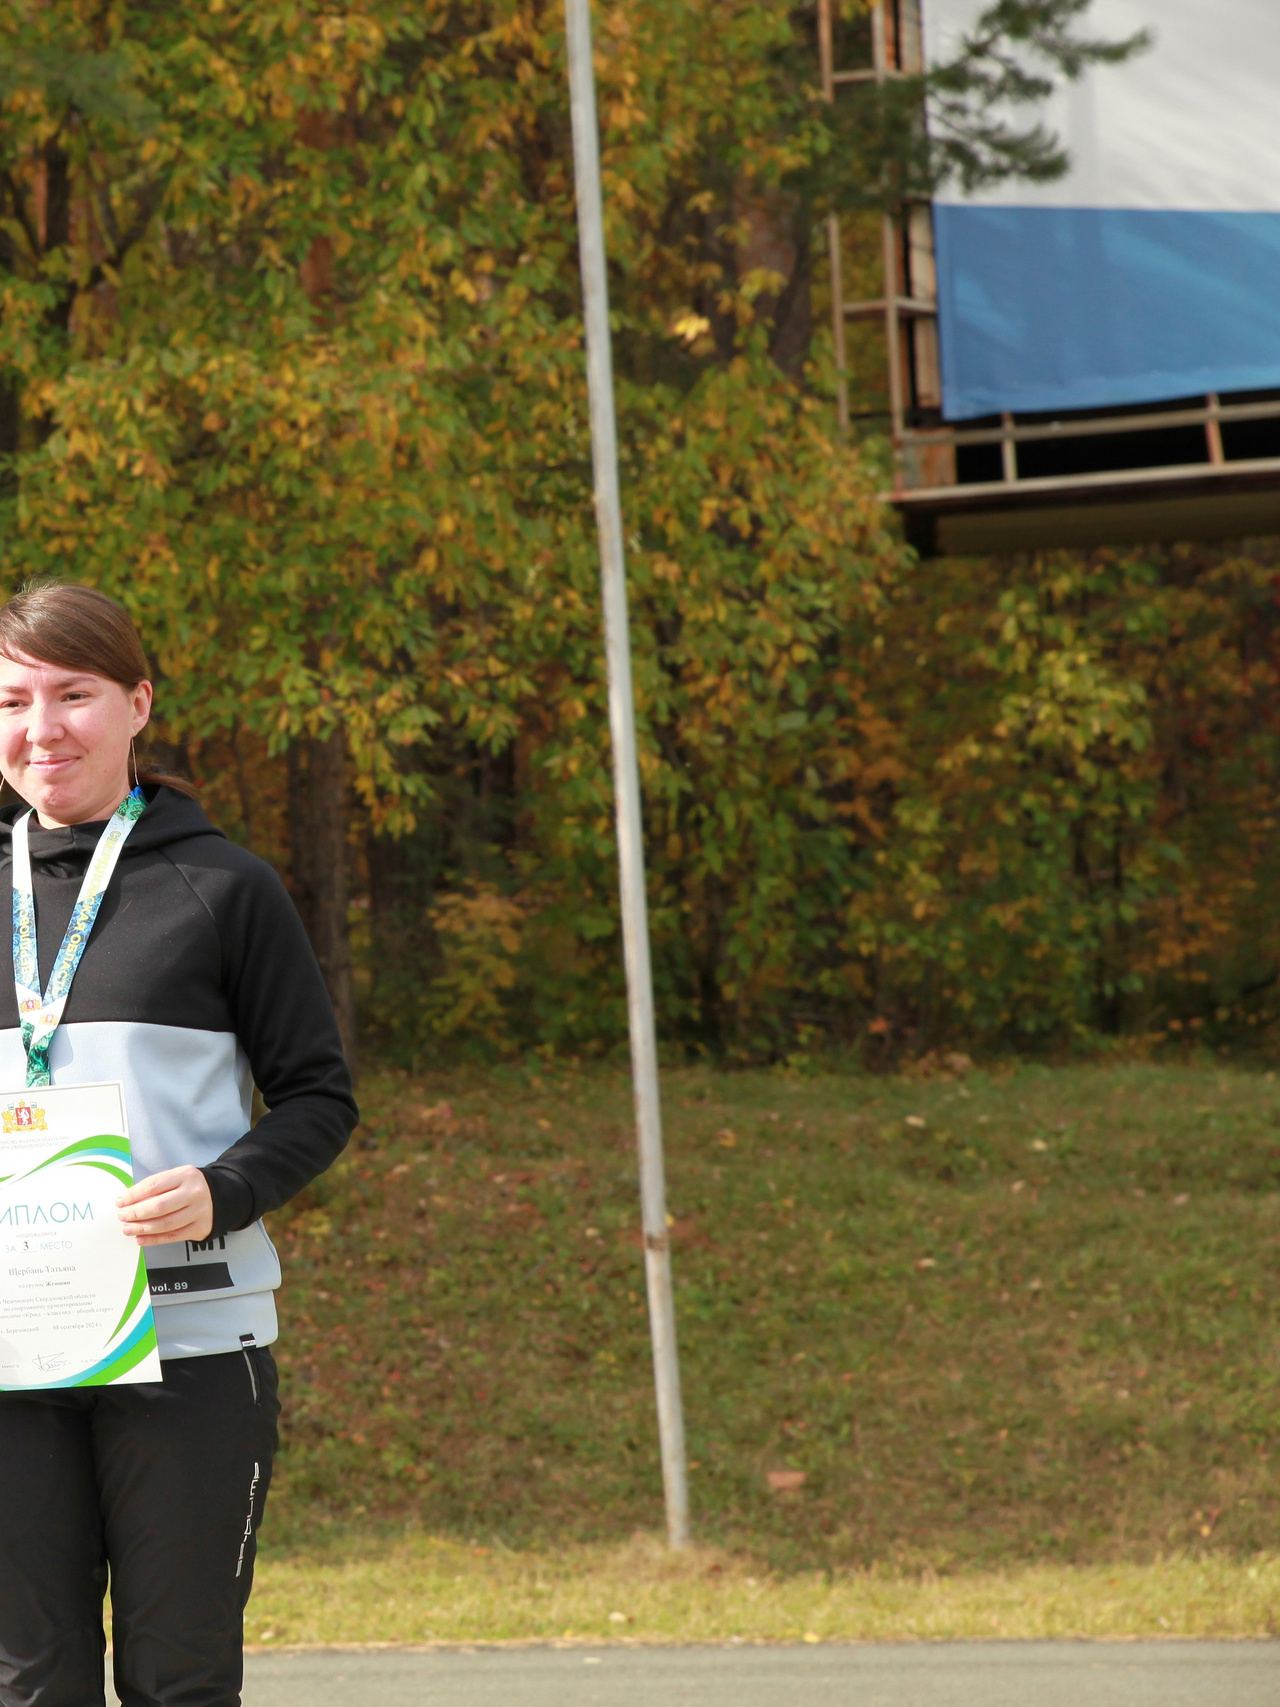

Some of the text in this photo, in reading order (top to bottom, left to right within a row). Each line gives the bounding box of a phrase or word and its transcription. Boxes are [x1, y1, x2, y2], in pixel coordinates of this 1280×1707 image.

[51, 932, 82, 997] ОБЛАСТЬ
[5, 1240, 73, 1253] ЗА 3 МЕСТО
[45, 1265, 77, 1274] Татьяна
[151, 1281, 189, 1293] vol. 89
